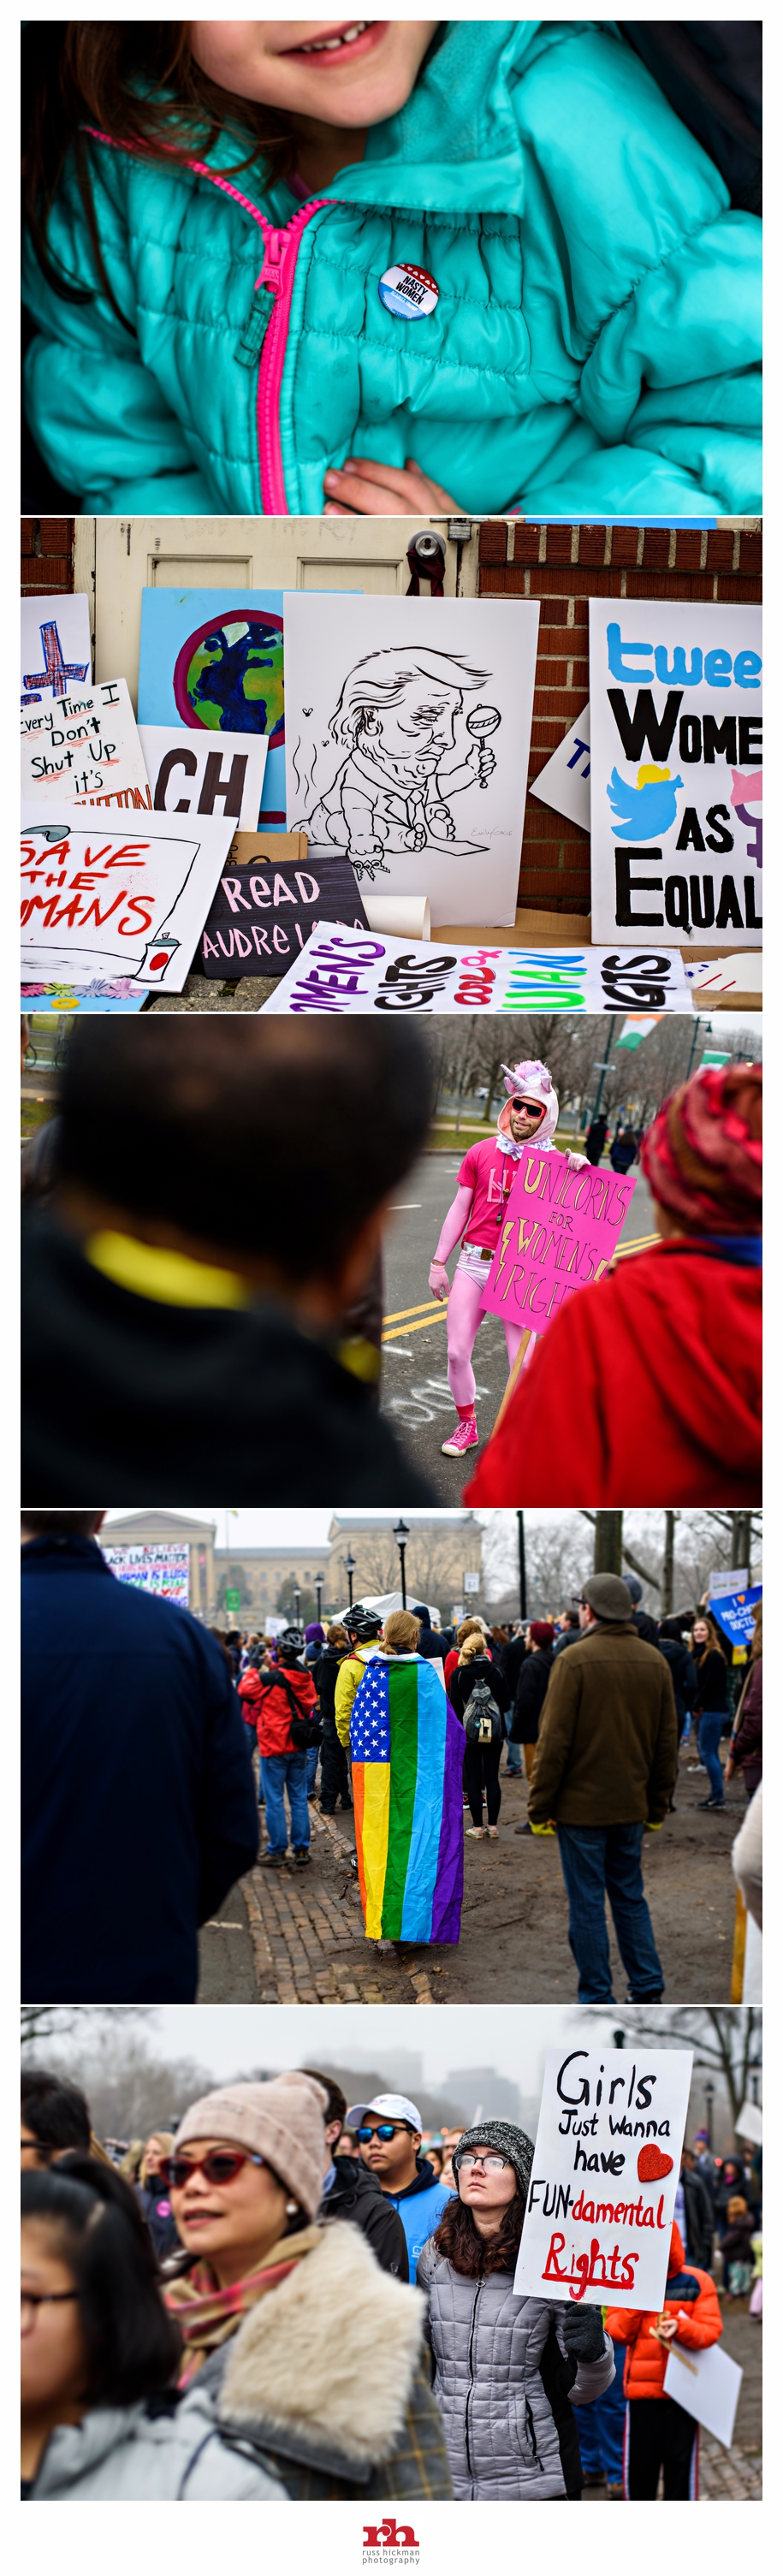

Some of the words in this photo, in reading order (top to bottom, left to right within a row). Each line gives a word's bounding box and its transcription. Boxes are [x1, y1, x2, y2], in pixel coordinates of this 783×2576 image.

[395, 282, 424, 306] WOMEN
[403, 276, 428, 296] NASTY
[607, 623, 762, 688] twee
[56, 697, 94, 718] Time
[101, 684, 120, 705] I
[51, 716, 100, 746] Don't
[607, 689, 762, 765] WOME
[32, 751, 74, 778] Shut
[89, 740, 116, 761] Up
[74, 769, 104, 794] it's
[676, 804, 734, 853] AS
[21, 840, 151, 869] SAVE
[21, 870, 110, 891] THE
[524, 1157, 632, 1226] UNICORNS
[549, 1211, 574, 1232] FOR
[518, 1216, 598, 1281] WOMEN'S
[129, 1553, 152, 1564] LIVES
[154, 1552, 187, 1564] MATTER
[557, 2050, 657, 2110] Girls
[559, 2110, 600, 2135] Just
[608, 2115, 670, 2138] Wanna
[573, 2140, 626, 2175] have
[545, 2232, 639, 2300] Rights
